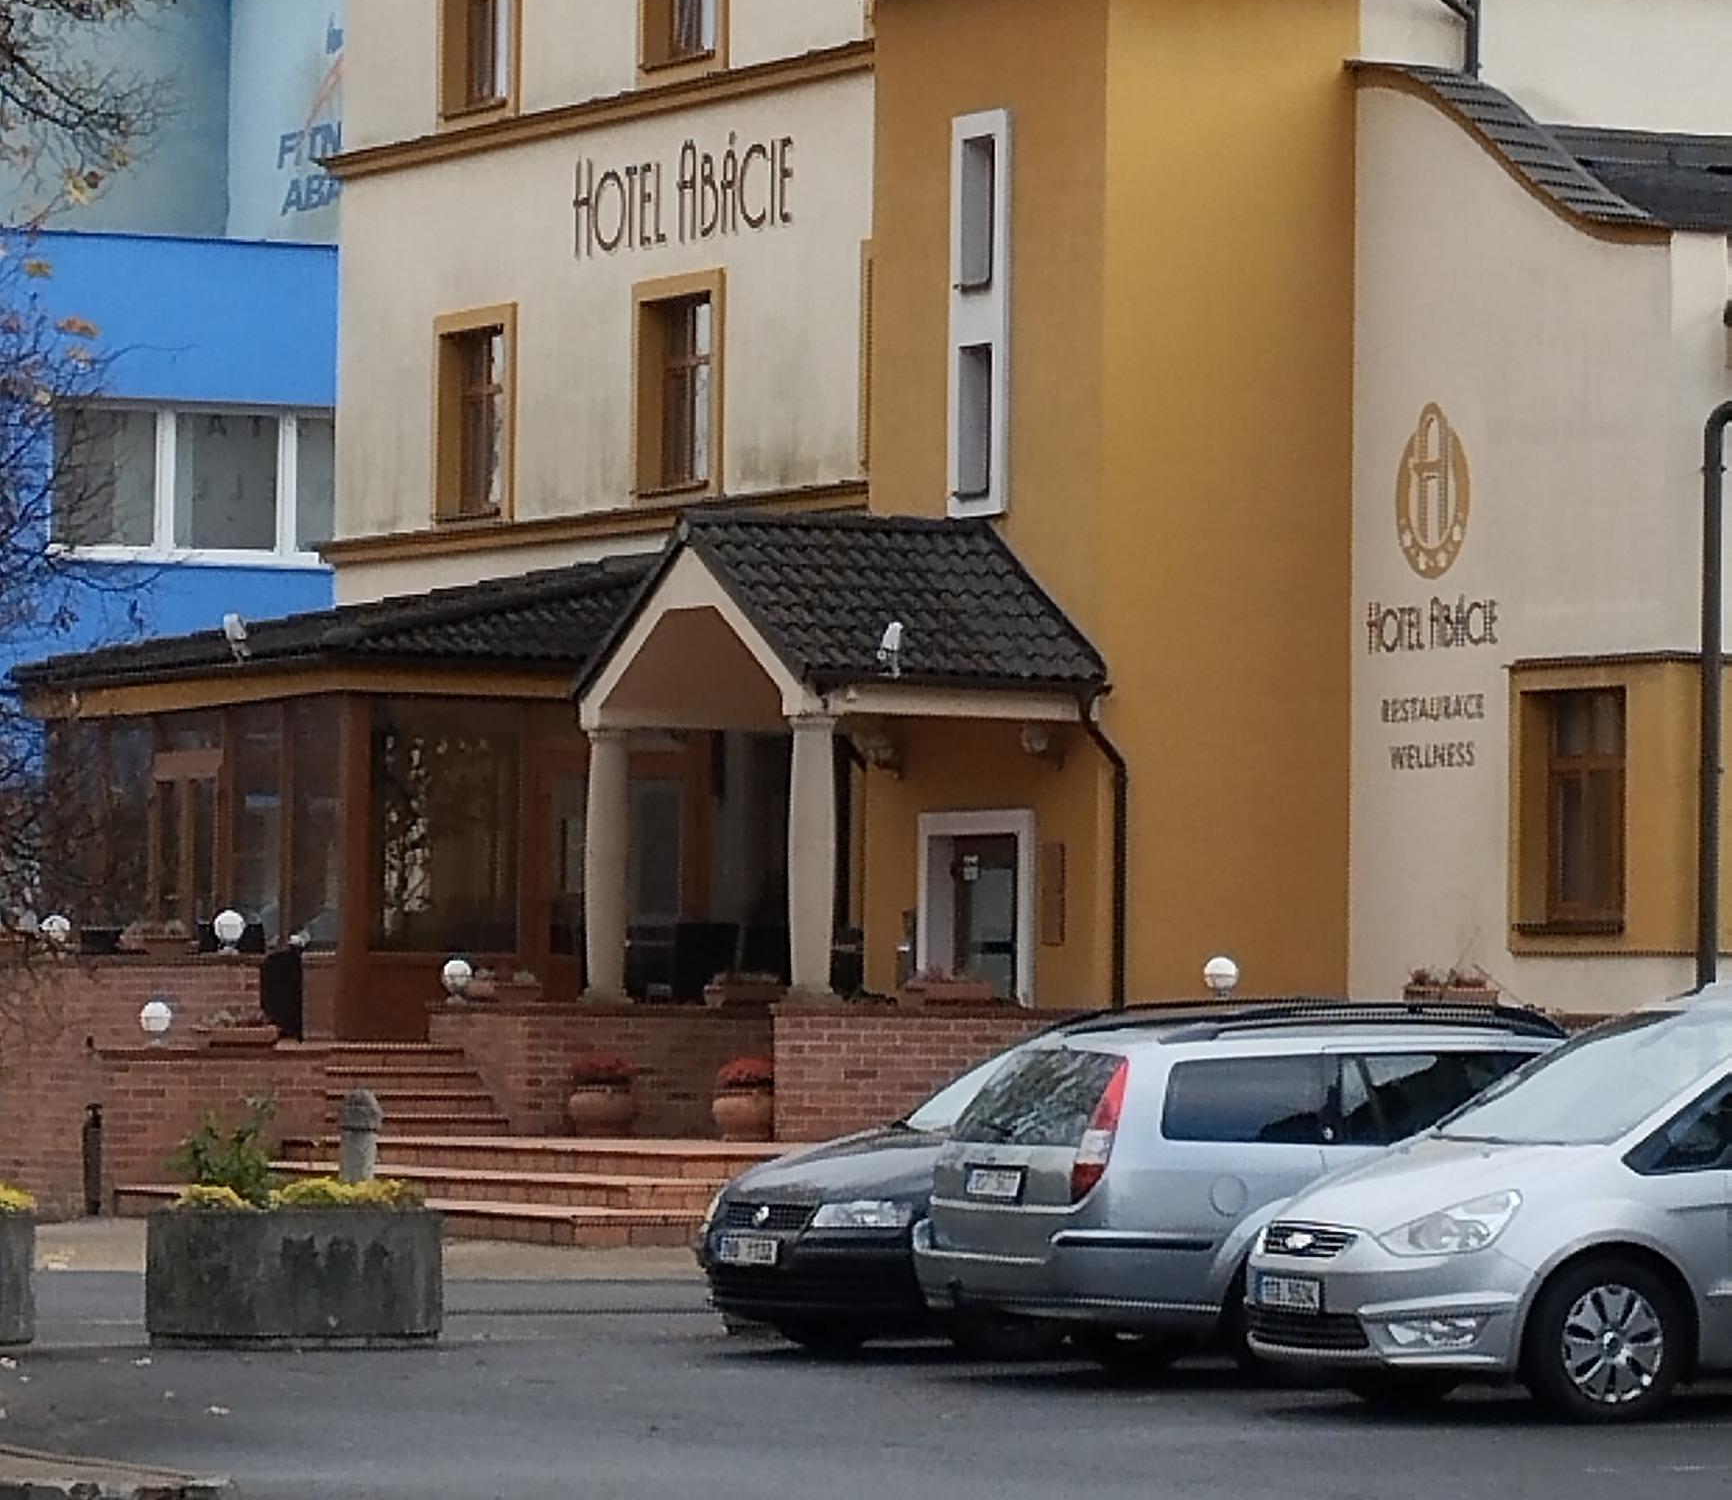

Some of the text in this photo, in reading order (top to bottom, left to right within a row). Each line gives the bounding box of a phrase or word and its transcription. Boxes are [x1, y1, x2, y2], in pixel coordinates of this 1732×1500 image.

[573, 155, 667, 260] HOTEL
[1381, 694, 1485, 724] RESTAURACE
[1389, 741, 1475, 771] WELLNESS
